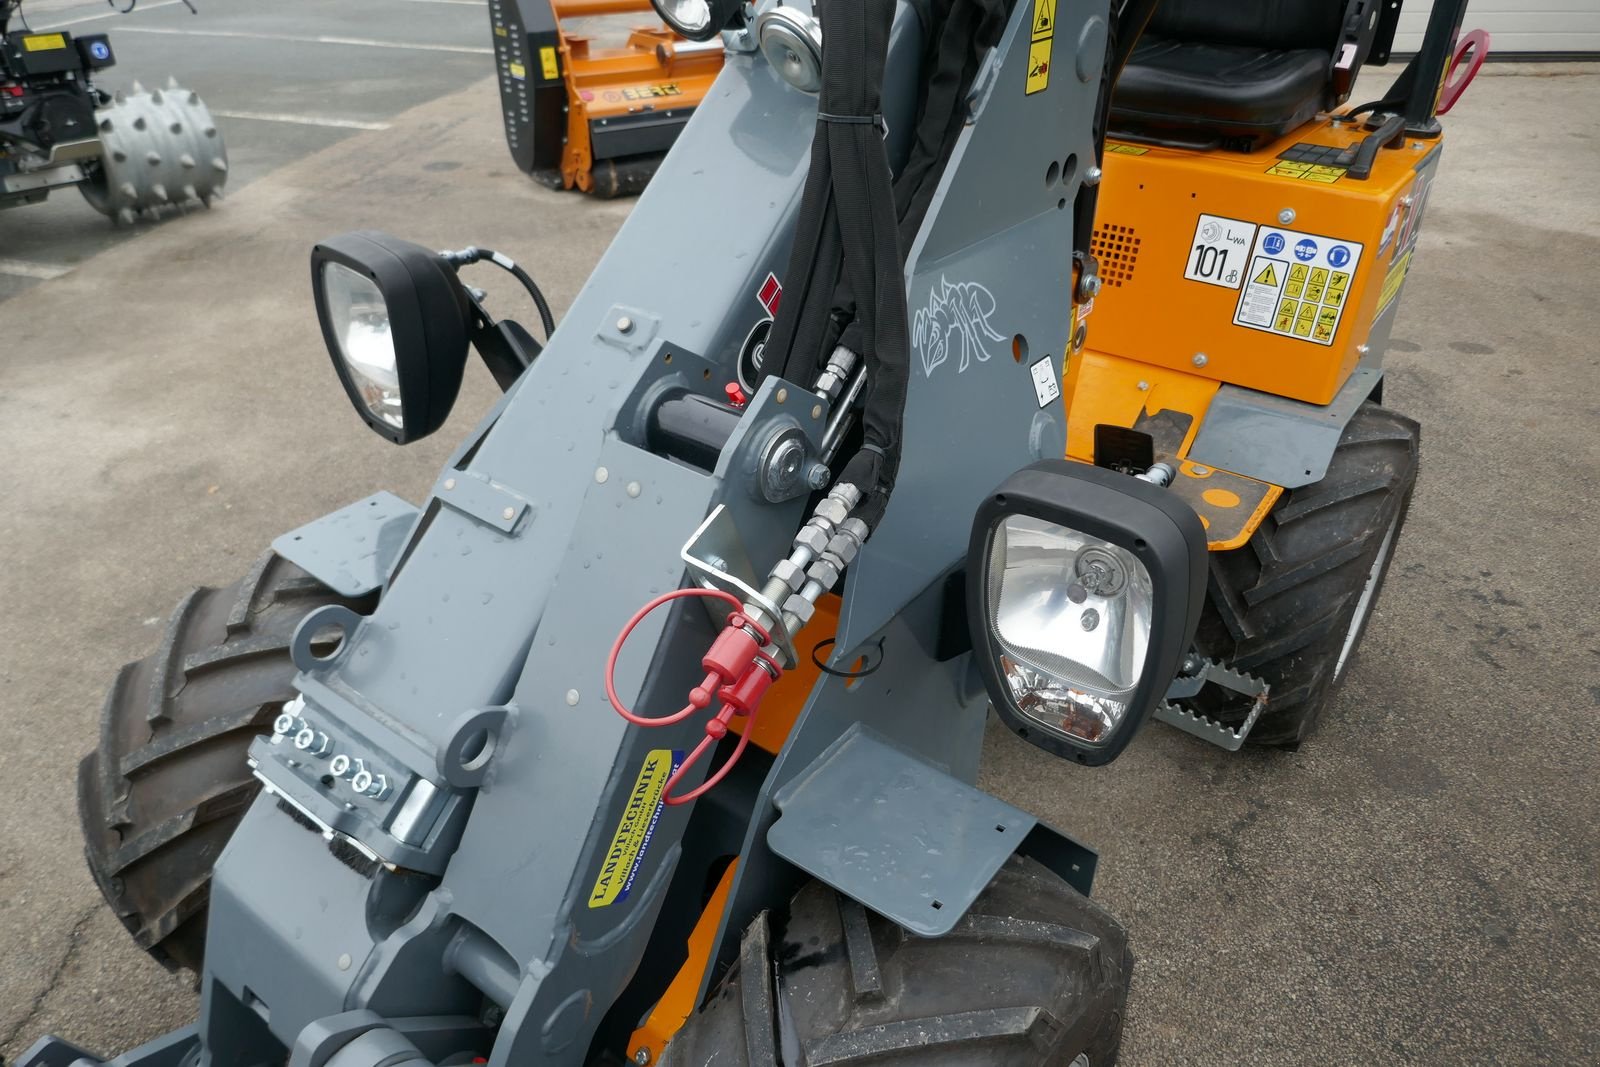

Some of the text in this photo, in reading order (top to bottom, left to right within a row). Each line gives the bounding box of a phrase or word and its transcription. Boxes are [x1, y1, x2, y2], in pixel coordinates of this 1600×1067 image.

[1193, 244, 1238, 284] 101 dB
[594, 758, 659, 901] LANDTECHNIK
[617, 849, 636, 885] Villach
[636, 771, 668, 838] Lieserbrücke
[622, 829, 637, 856] Villach
